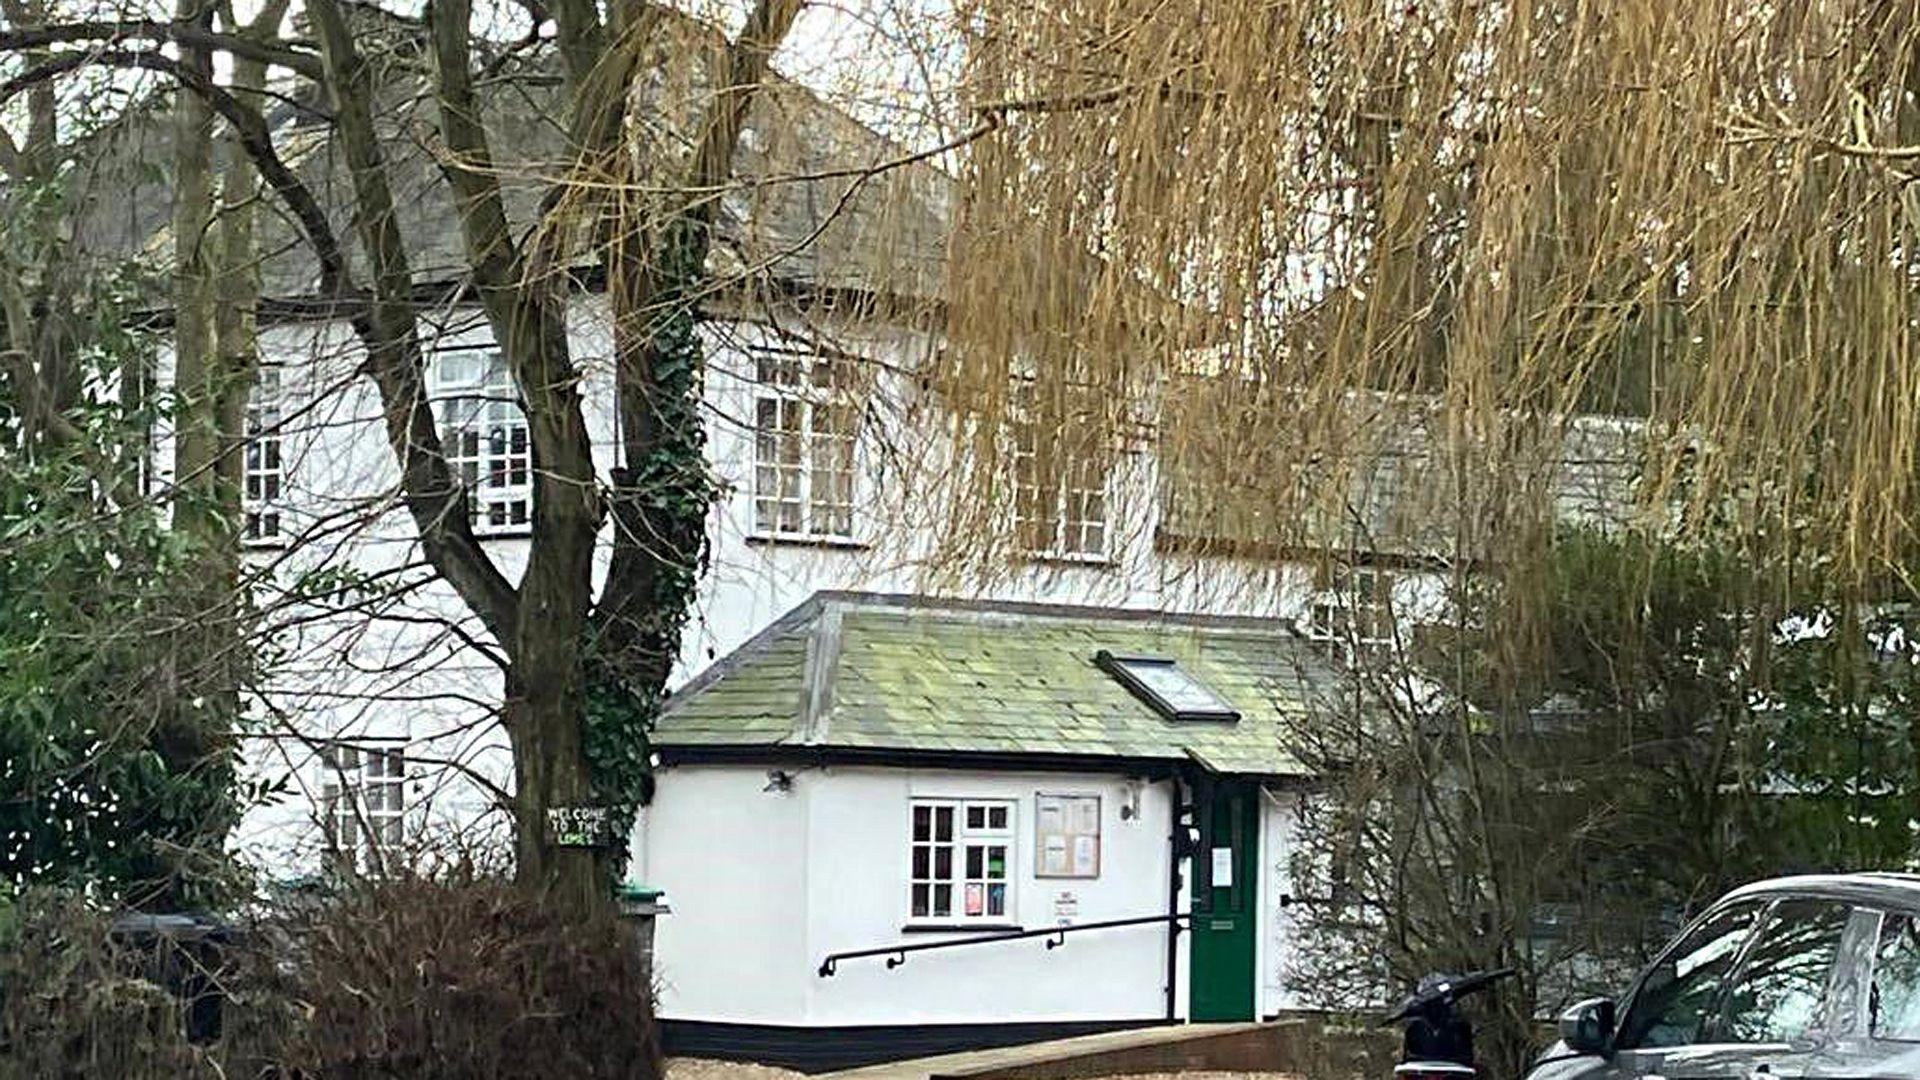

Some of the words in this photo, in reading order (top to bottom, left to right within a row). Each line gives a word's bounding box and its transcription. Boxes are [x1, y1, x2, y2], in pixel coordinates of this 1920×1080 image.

[547, 807, 607, 821] WELCOME
[551, 820, 569, 833] TO
[577, 820, 601, 834] THE
